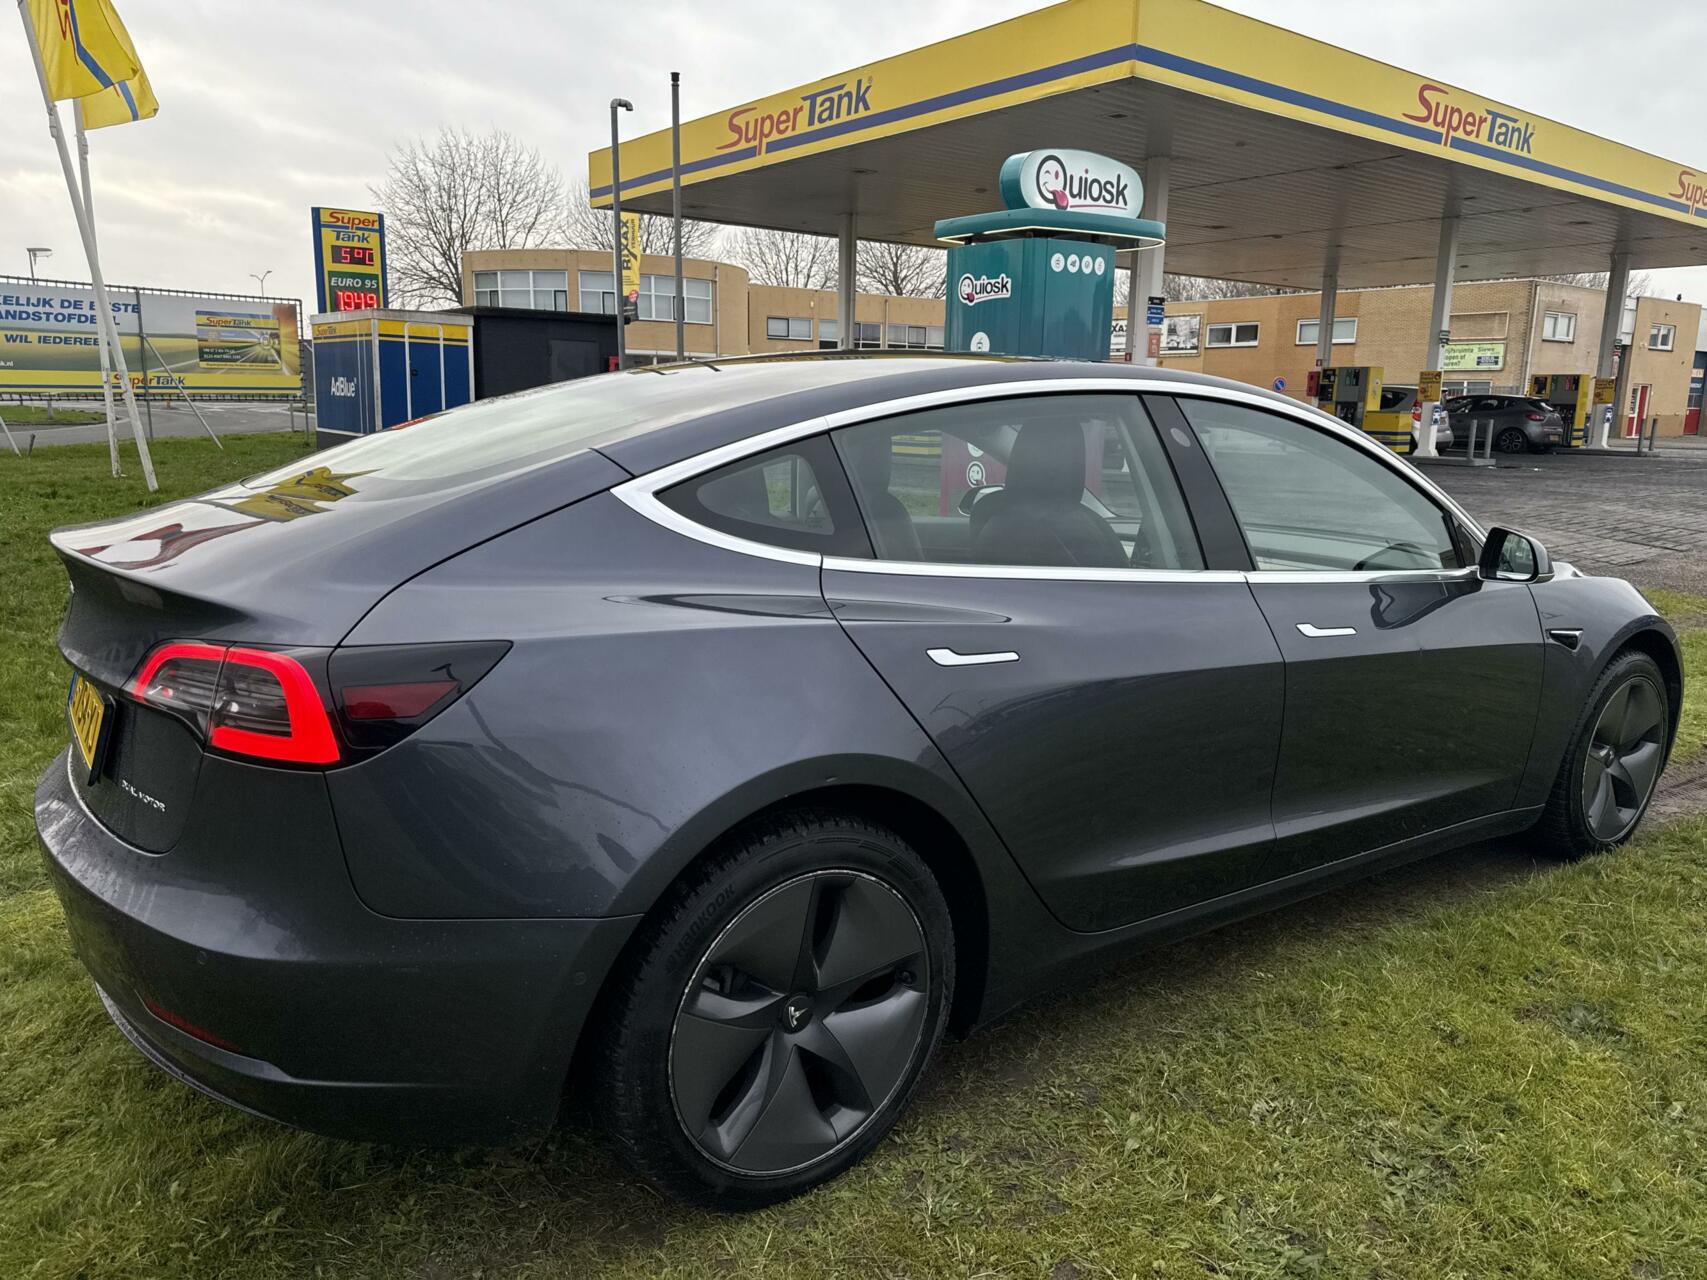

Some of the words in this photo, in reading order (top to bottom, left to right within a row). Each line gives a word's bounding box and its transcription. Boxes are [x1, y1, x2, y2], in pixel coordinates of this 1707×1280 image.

[715, 78, 872, 156] SuperTank
[1402, 84, 1534, 154] SuperTank
[1036, 155, 1128, 209] Quiosk
[320, 211, 378, 230] Super
[331, 230, 370, 244] Tank
[330, 277, 362, 287] EURO
[364, 280, 378, 289] 95
[960, 276, 1009, 303] Quiosk
[0, 295, 54, 308] ELIJK
[60, 299, 84, 310] DE
[89, 301, 140, 313] STE
[0, 310, 120, 325] NDSTOFDEL
[4, 334, 32, 343] WIL
[38, 335, 111, 346] IEDEREE
[112, 372, 186, 390] SperTank
[330, 376, 356, 397] AdBlue
